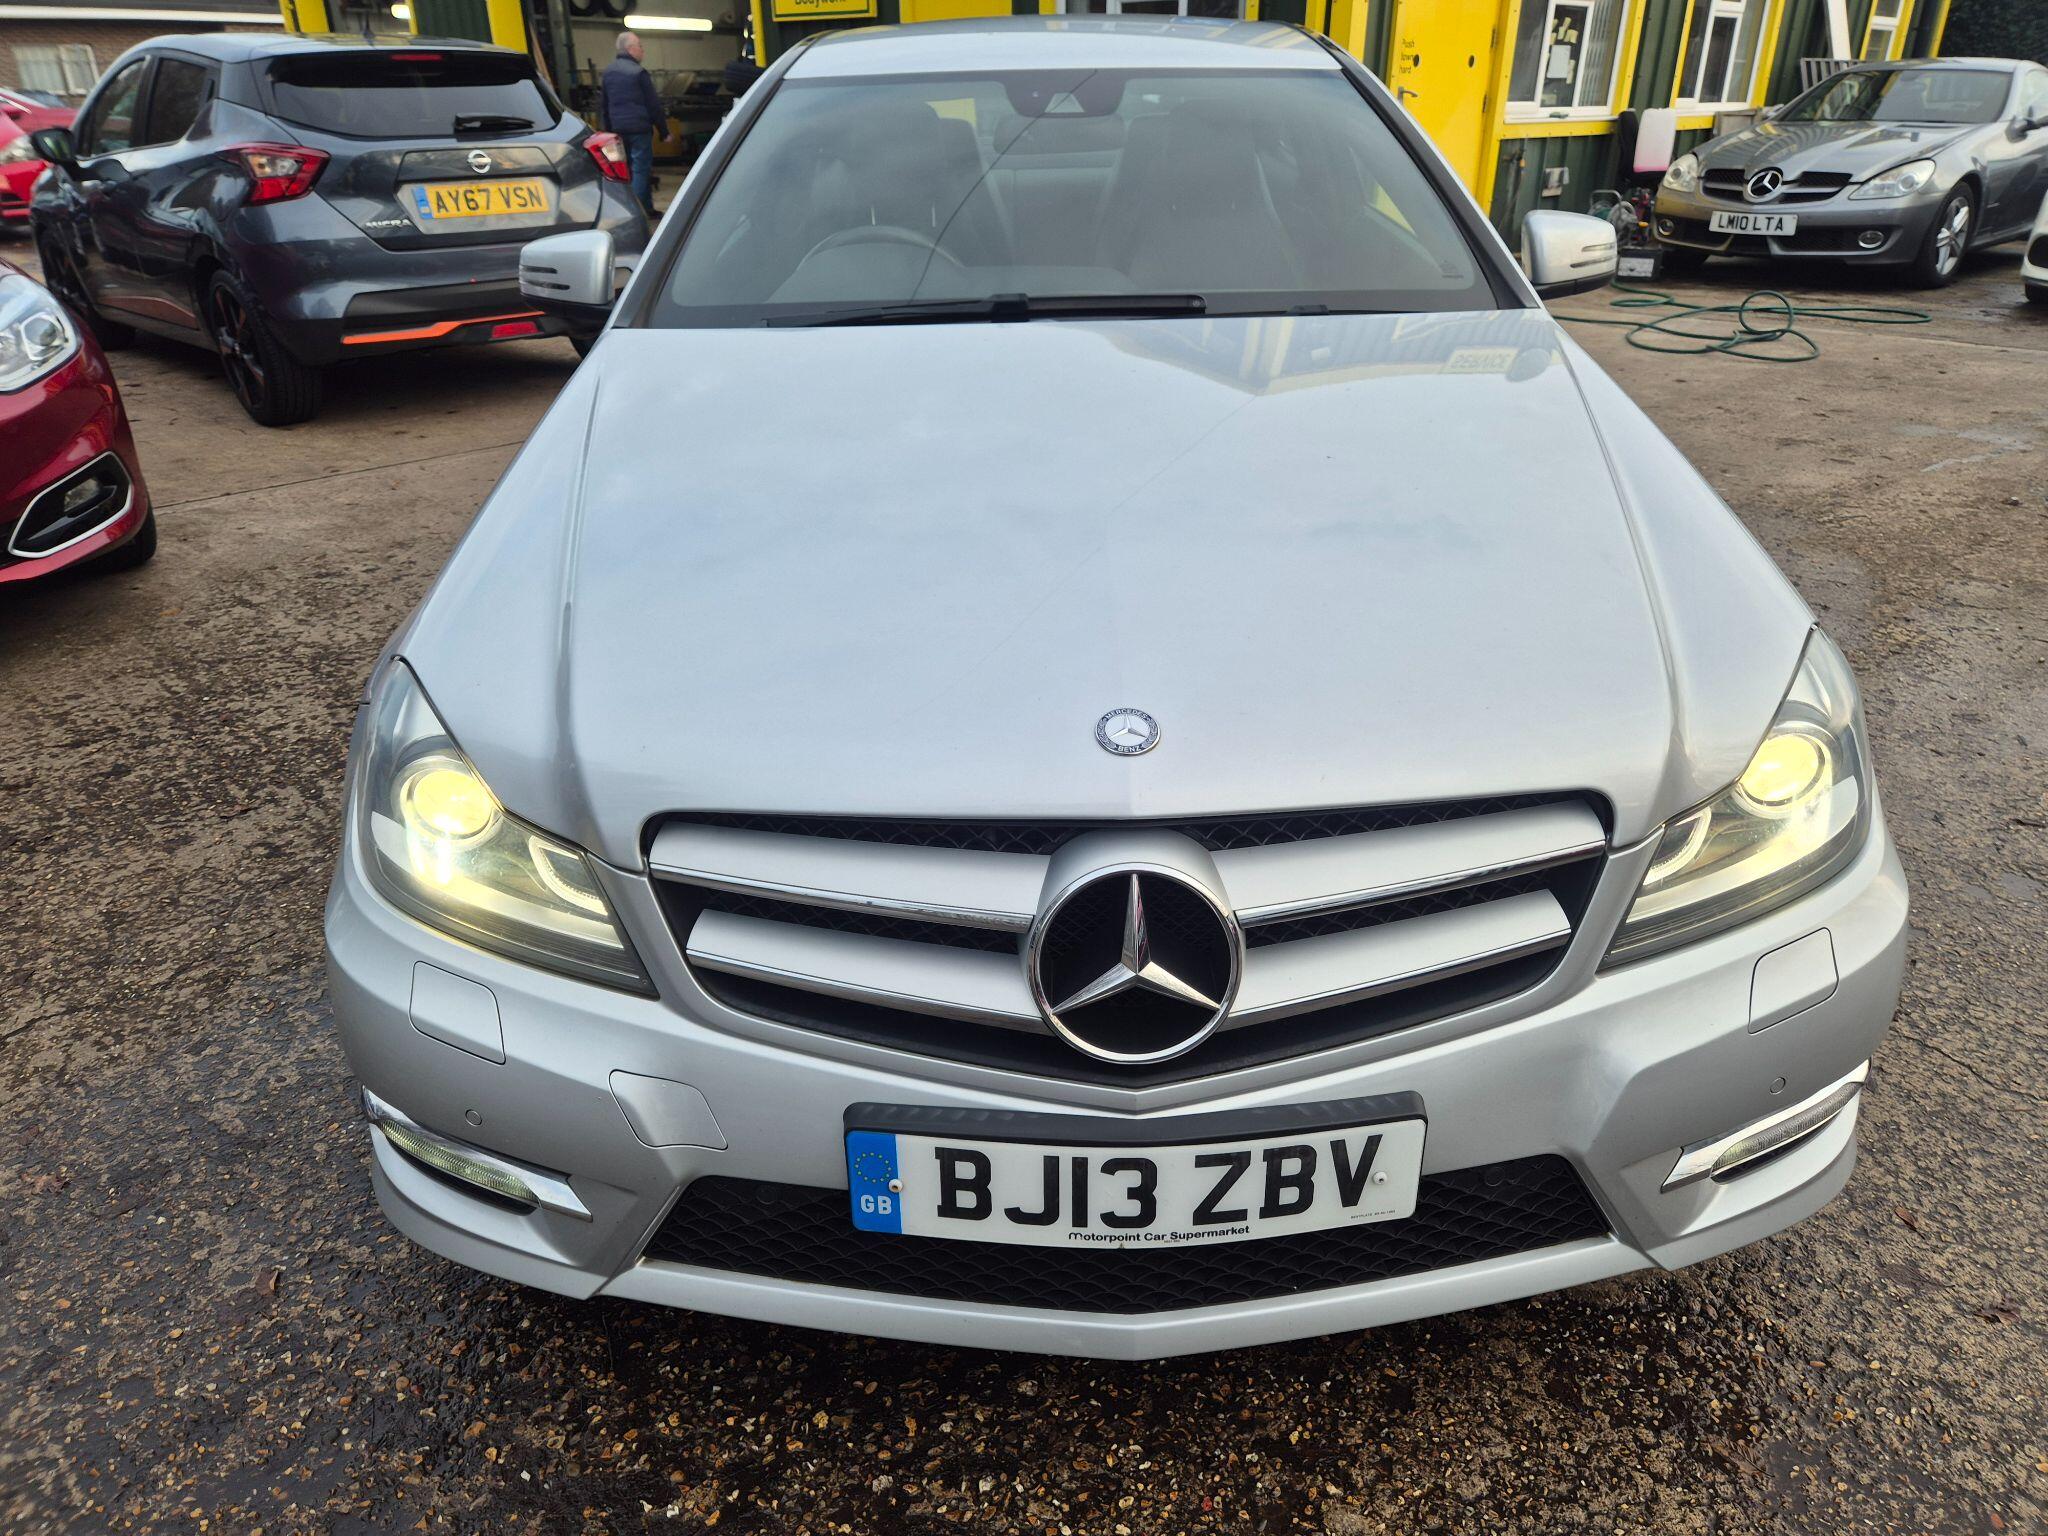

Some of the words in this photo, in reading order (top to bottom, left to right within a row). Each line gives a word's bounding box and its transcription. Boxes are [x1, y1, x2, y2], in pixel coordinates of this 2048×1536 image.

[434, 187, 491, 213] AY67
[498, 185, 543, 209] VSN
[1717, 214, 1749, 231] LM10
[1752, 215, 1784, 232] LTA
[1105, 708, 1148, 721] MERCEDES
[1117, 745, 1142, 753] BENZ
[934, 1146, 1158, 1229] BJ13
[1192, 1133, 1384, 1227] ZBV
[860, 1194, 892, 1215] GB
[1068, 1232, 1141, 1244] Motorpoint
[1144, 1232, 1167, 1242] Car
[1169, 1225, 1250, 1242] Supermarket
